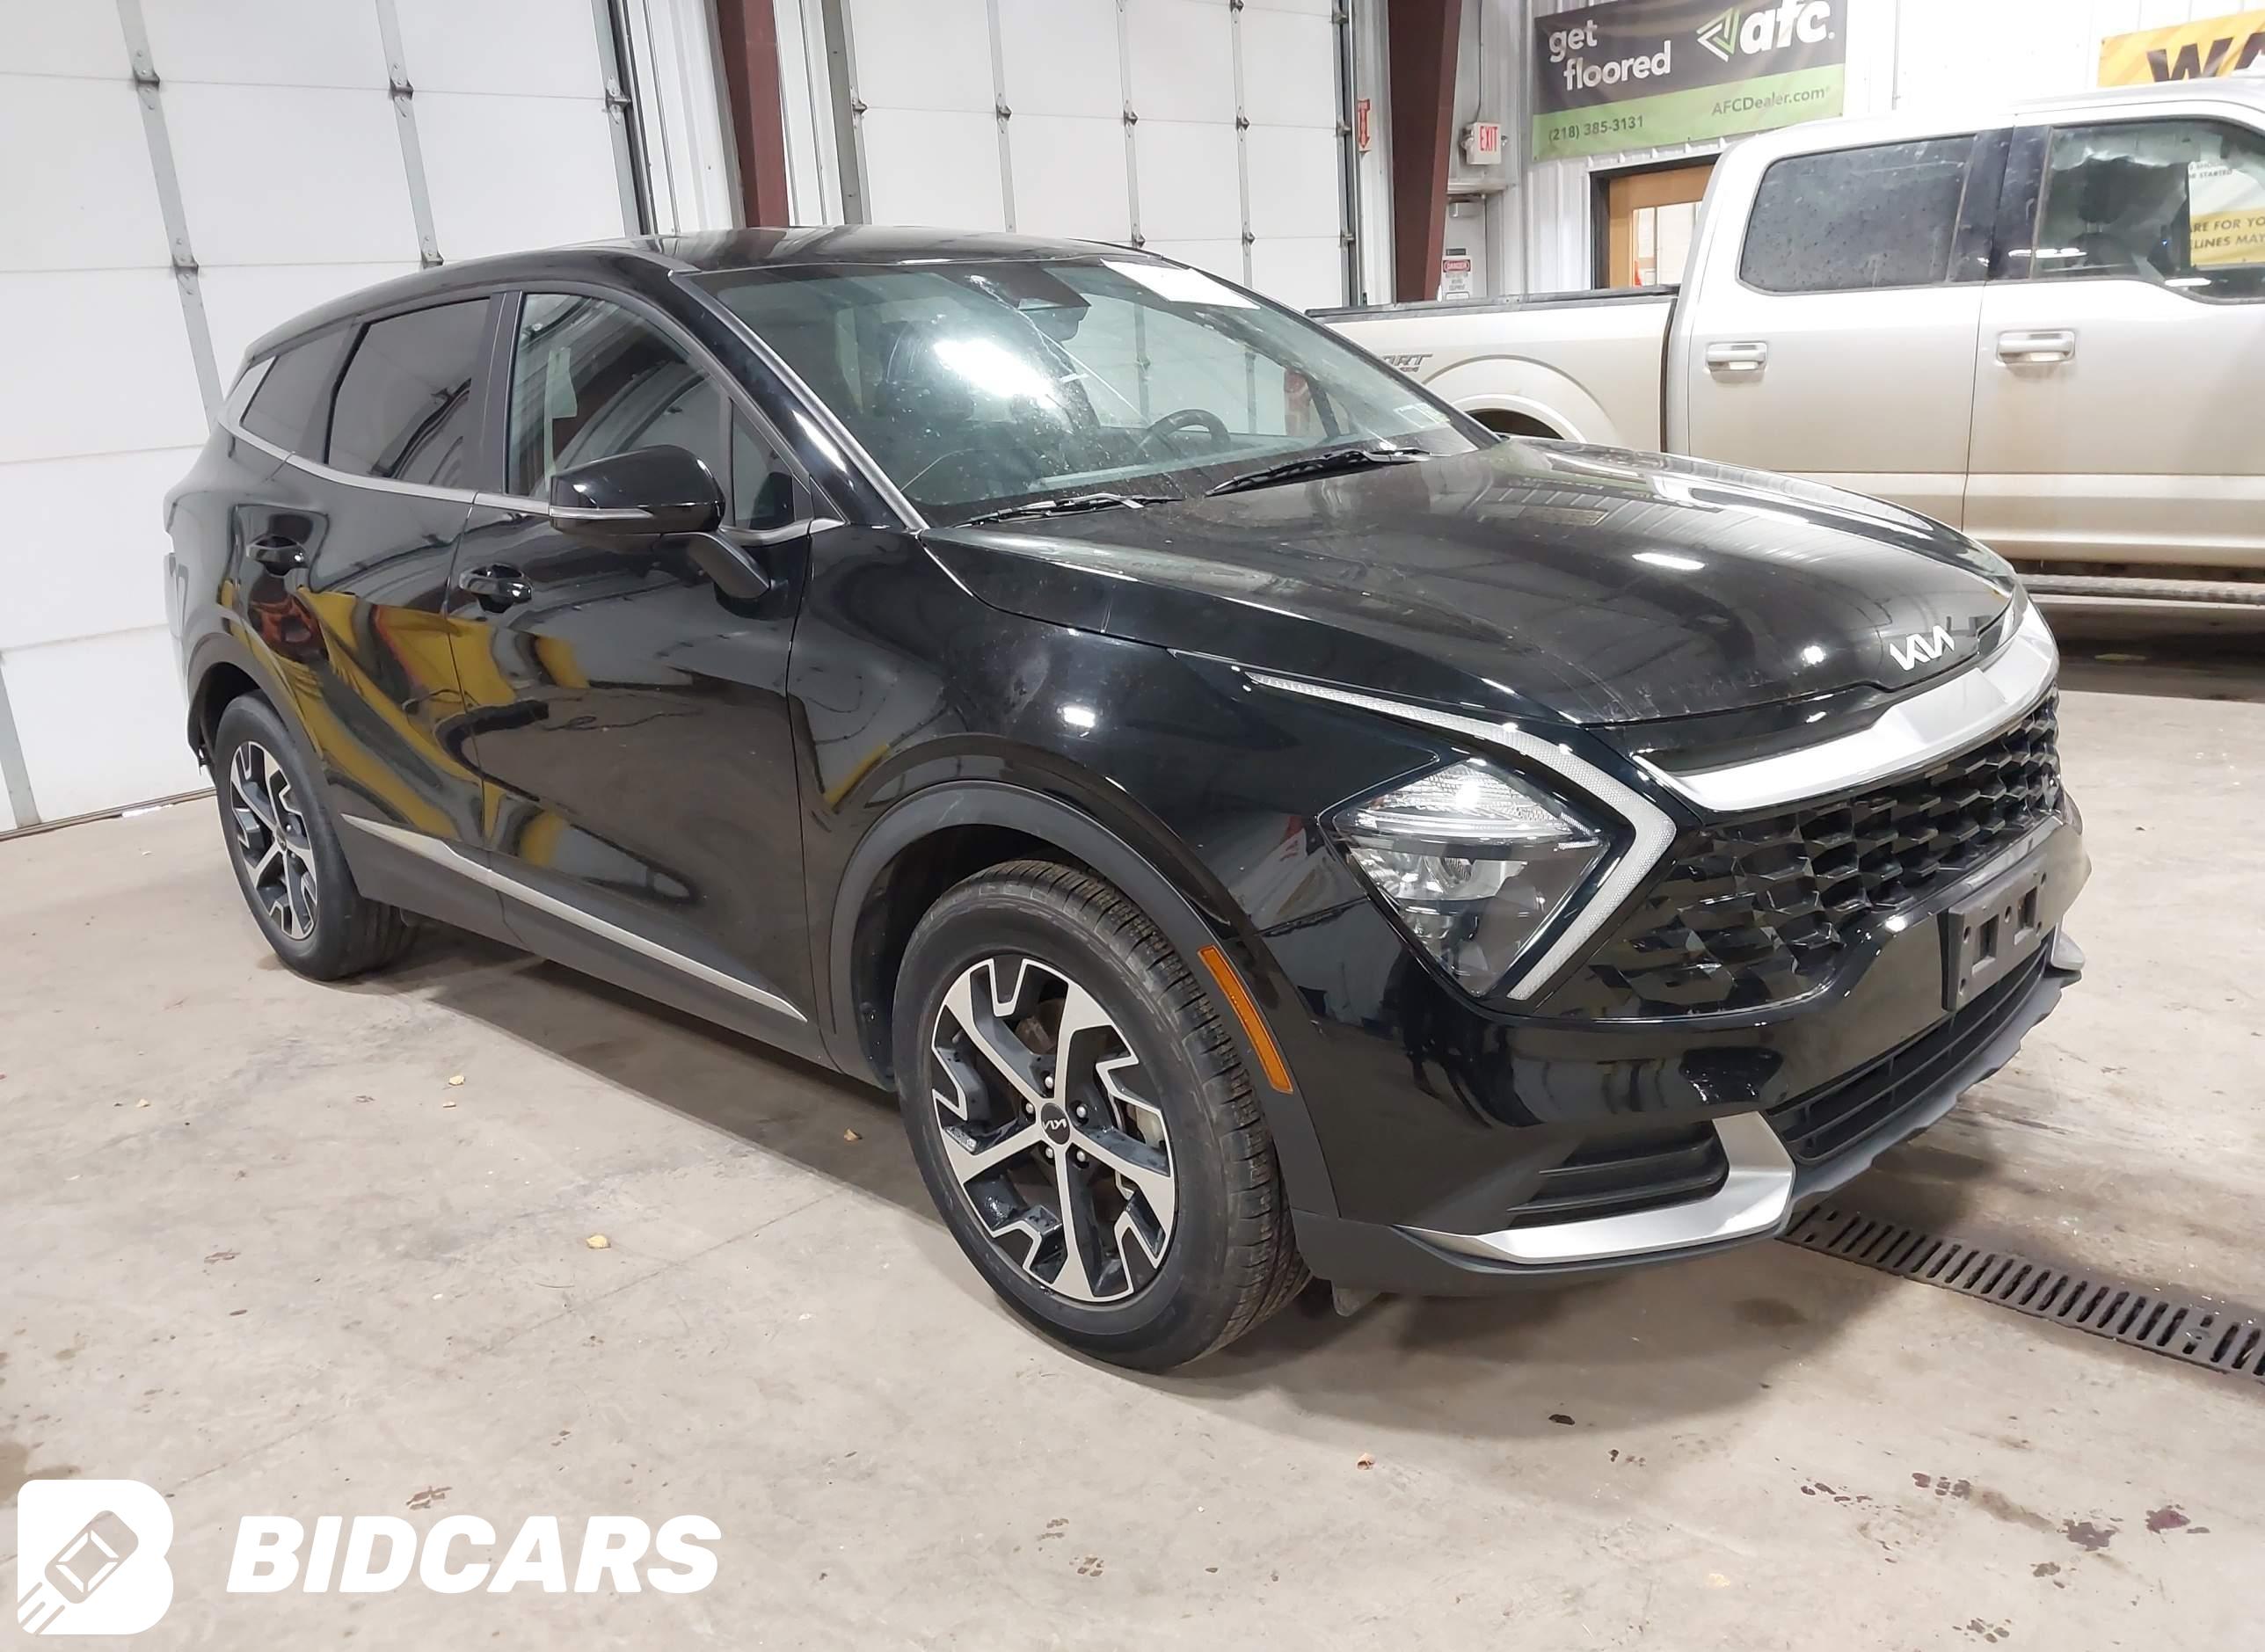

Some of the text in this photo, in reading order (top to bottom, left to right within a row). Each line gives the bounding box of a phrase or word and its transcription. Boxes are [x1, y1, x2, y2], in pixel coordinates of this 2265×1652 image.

[1548, 19, 1599, 63] get
[1563, 40, 1671, 91] floored
[1712, 87, 1825, 116] AFCDealer.com
[1479, 126, 1498, 152] EXIT
[1548, 115, 1644, 142] (218) 385-3131
[2214, 219, 2241, 230] FOR
[1890, 625, 1955, 671] KIA
